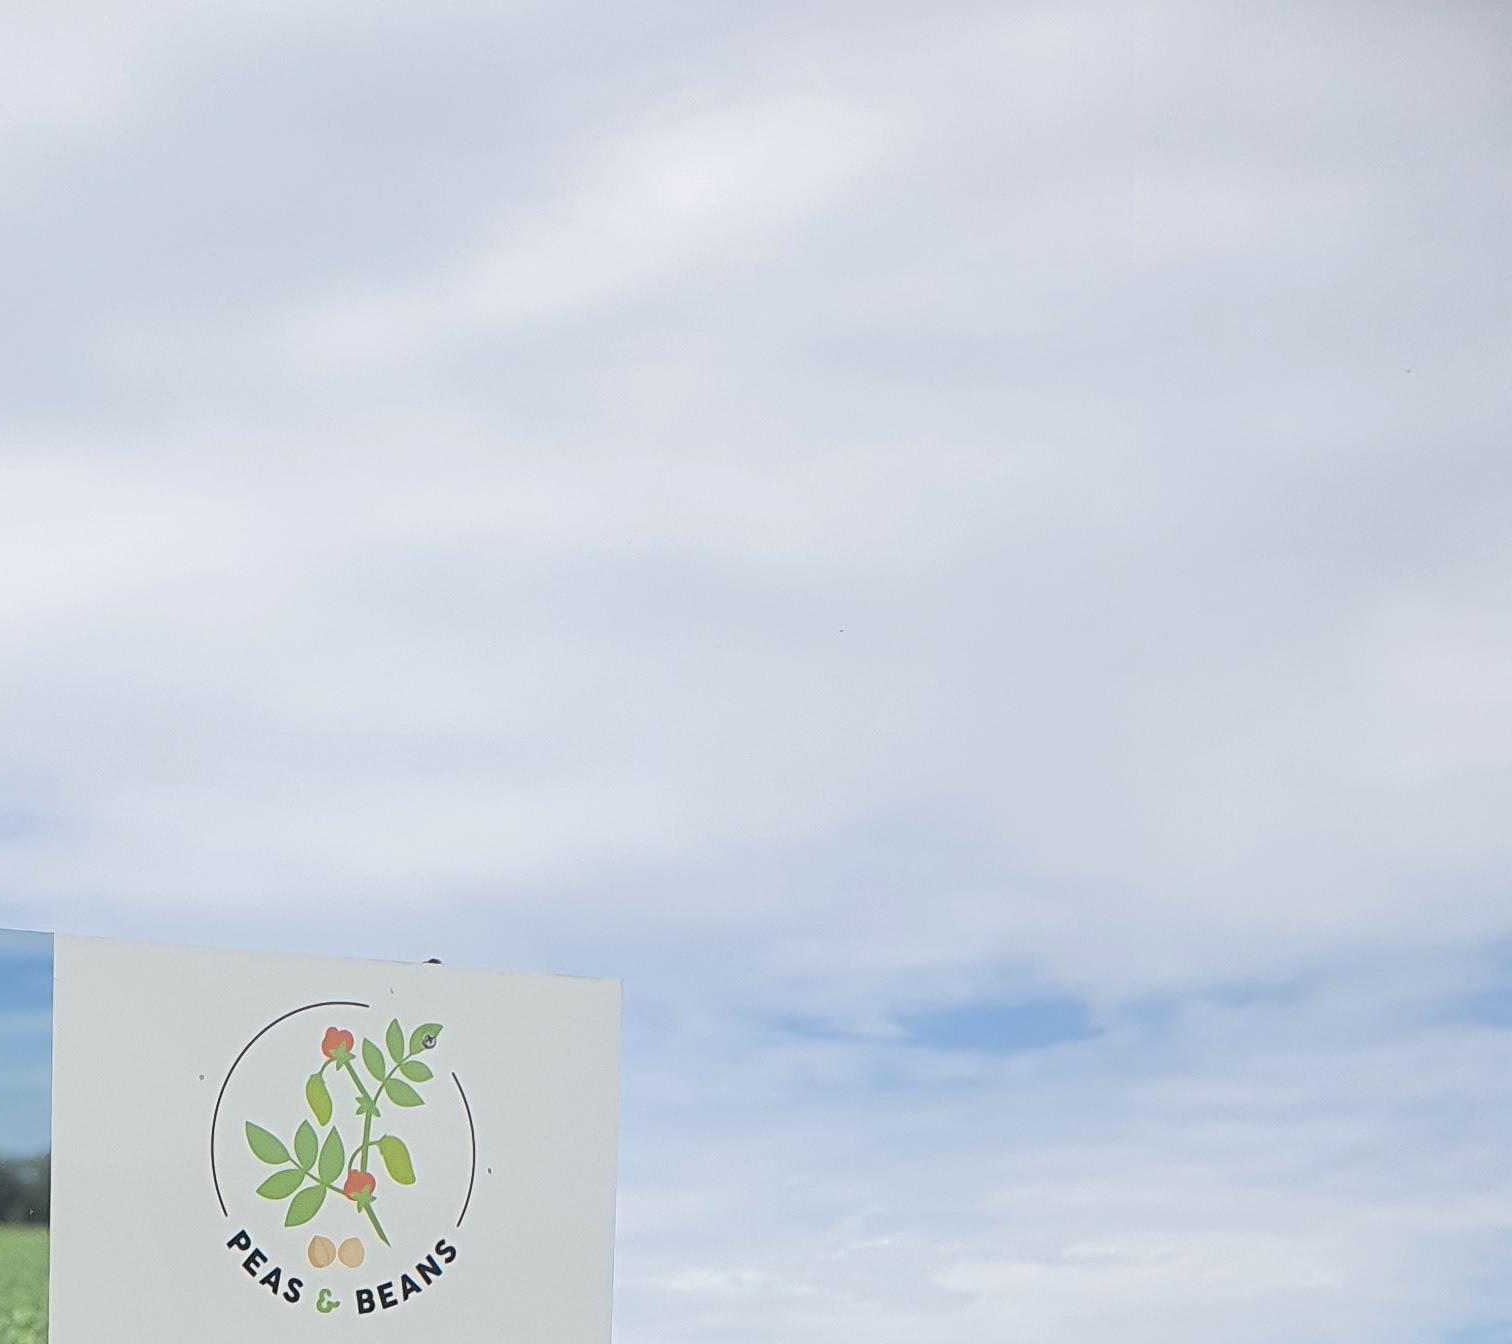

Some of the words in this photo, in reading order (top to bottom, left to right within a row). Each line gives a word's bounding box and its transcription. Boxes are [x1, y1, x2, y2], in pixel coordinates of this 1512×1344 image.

[226, 1228, 304, 1305] PEAS
[315, 1288, 341, 1314] &
[355, 1238, 459, 1315] BEANS
